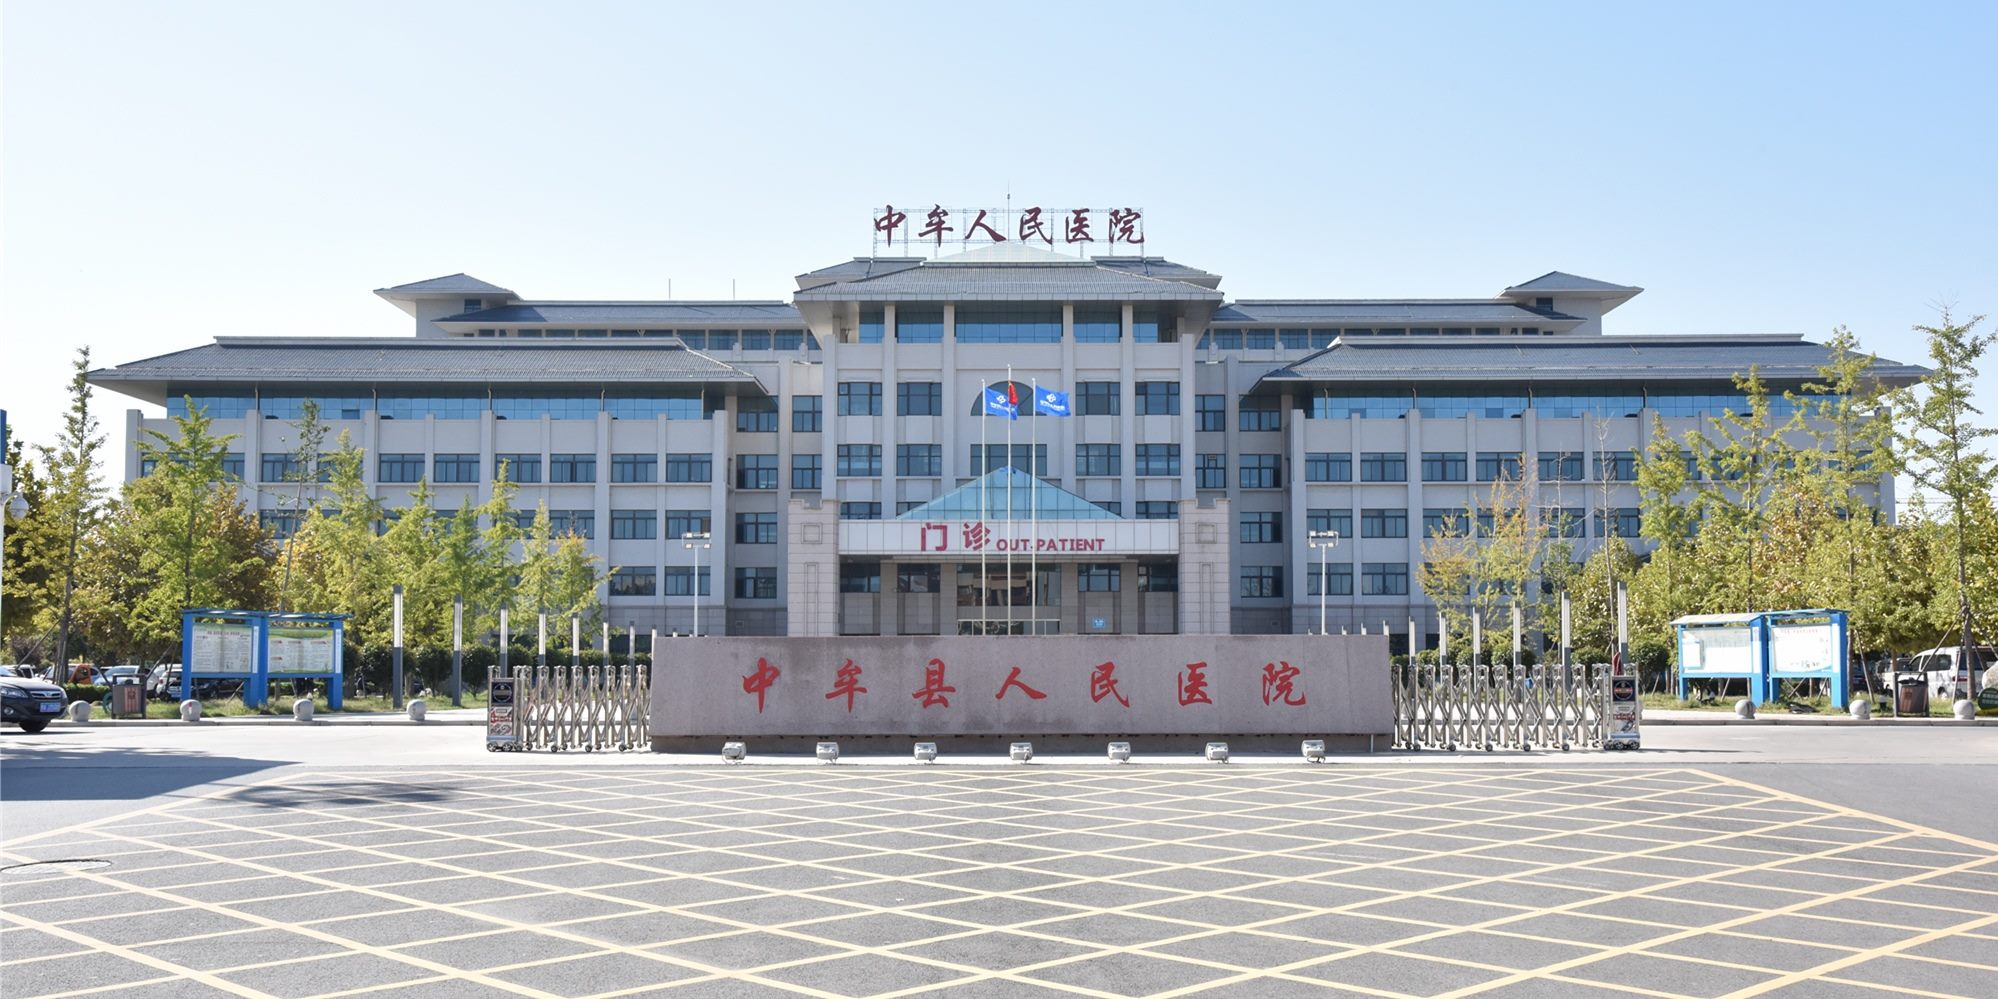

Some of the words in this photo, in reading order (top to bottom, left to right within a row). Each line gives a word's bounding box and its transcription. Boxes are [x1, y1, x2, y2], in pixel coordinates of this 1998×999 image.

[873, 204, 1145, 248] 中牟人民医院
[920, 522, 991, 552] 门诊
[742, 656, 1307, 714] 中牟县人民医院
